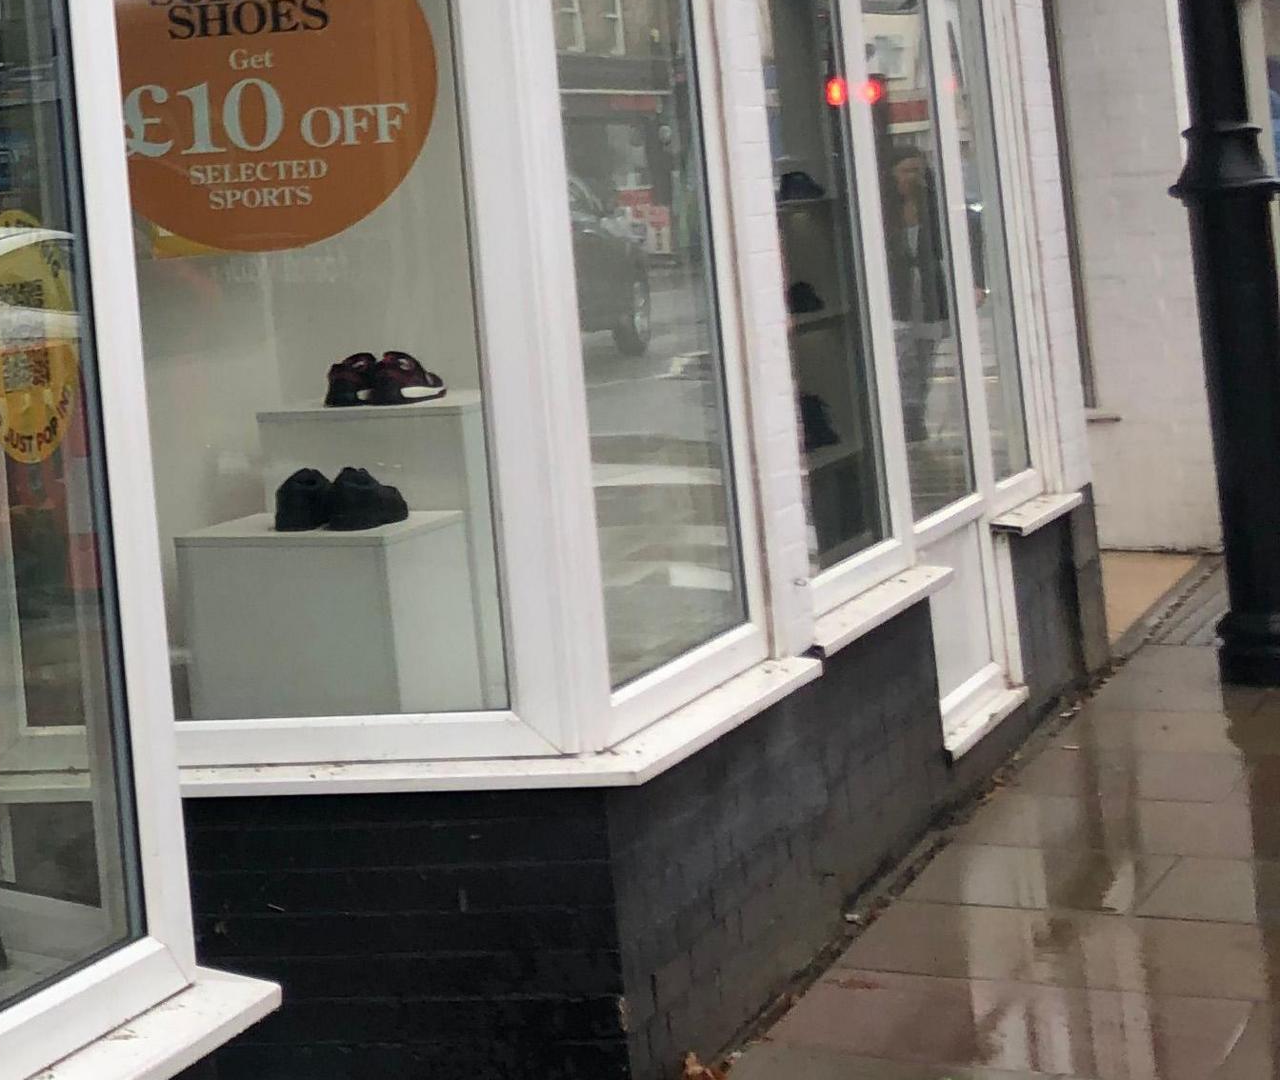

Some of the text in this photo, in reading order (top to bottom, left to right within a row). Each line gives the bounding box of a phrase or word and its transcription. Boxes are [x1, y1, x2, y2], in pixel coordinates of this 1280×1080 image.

[229, 48, 273, 70] Get
[123, 78, 410, 157] £10 OFF
[189, 159, 328, 185] SELECTED
[209, 186, 313, 210] SPORTS
[4, 428, 32, 453] JUST
